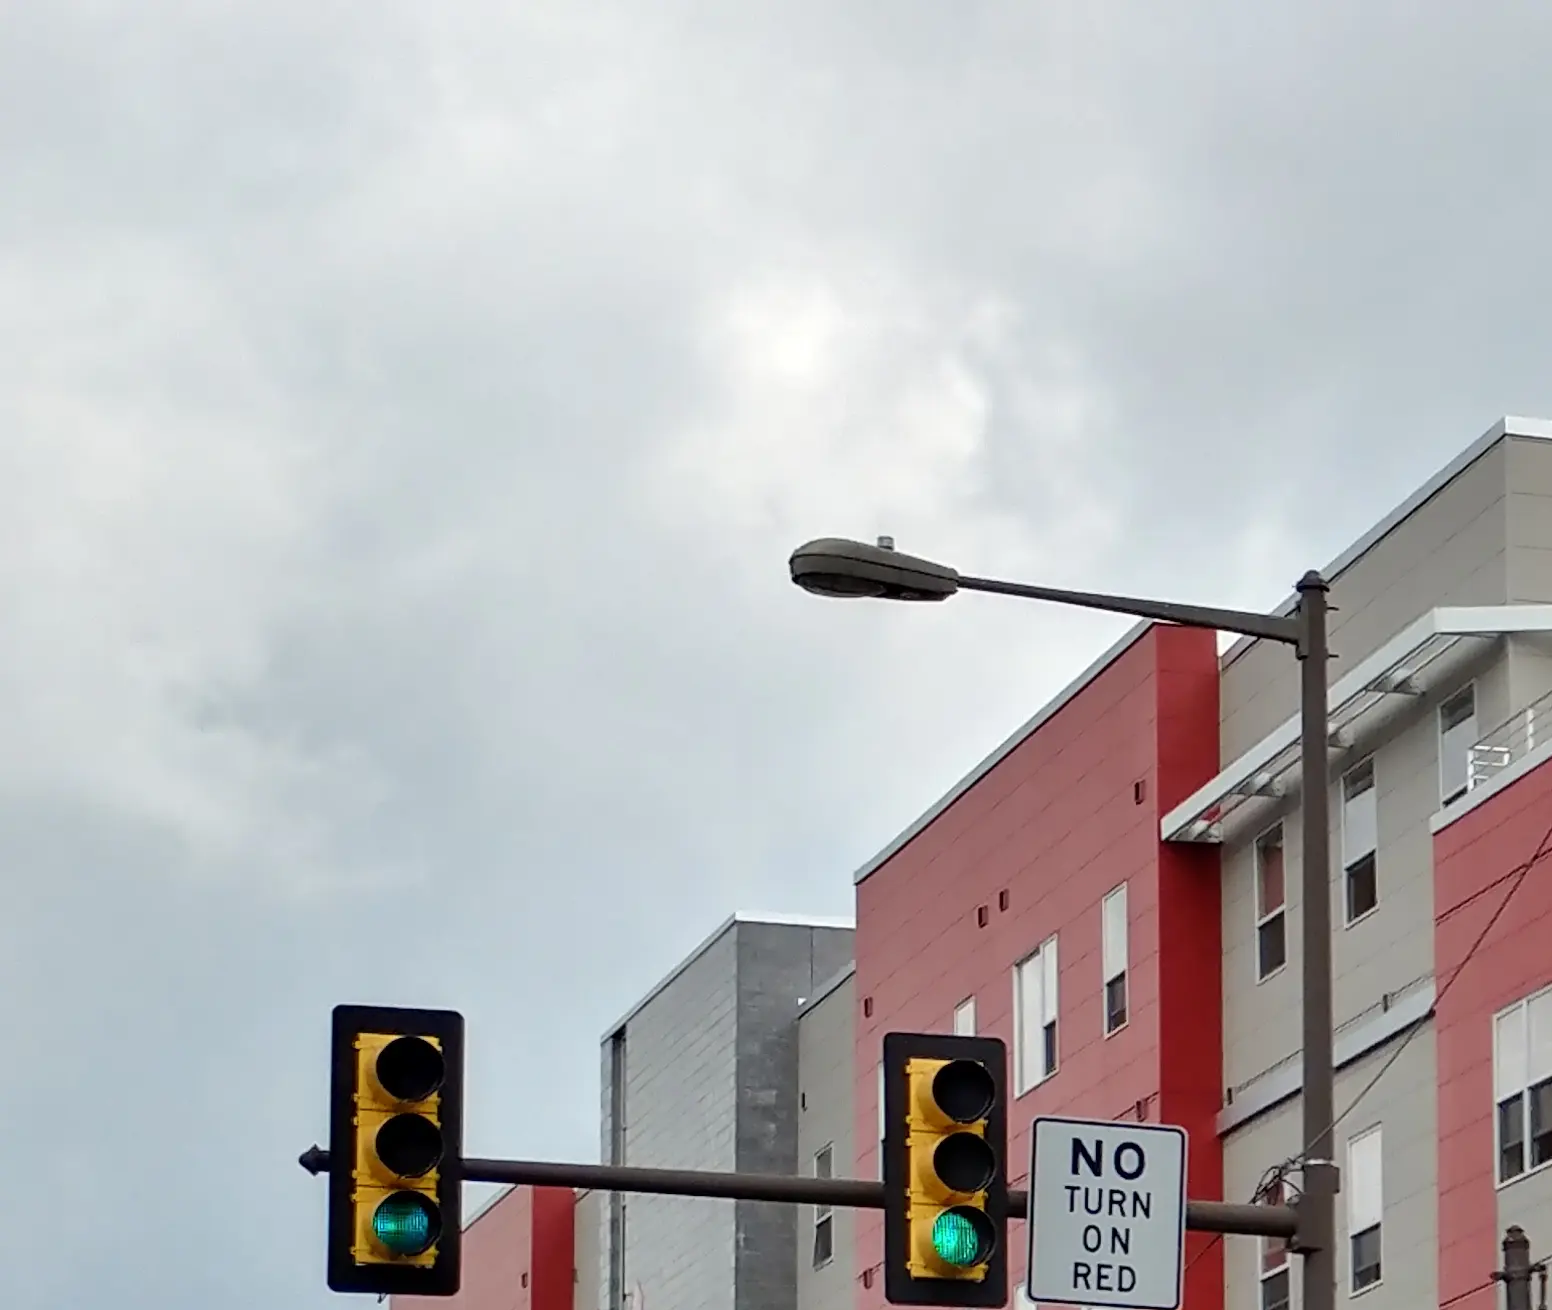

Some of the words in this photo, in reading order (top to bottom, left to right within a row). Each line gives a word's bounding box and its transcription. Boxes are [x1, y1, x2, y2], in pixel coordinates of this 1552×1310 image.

[1071, 1137, 1146, 1181] NO
[1064, 1185, 1152, 1219] TURN
[1083, 1224, 1130, 1255] ON
[1072, 1262, 1137, 1293] RED
